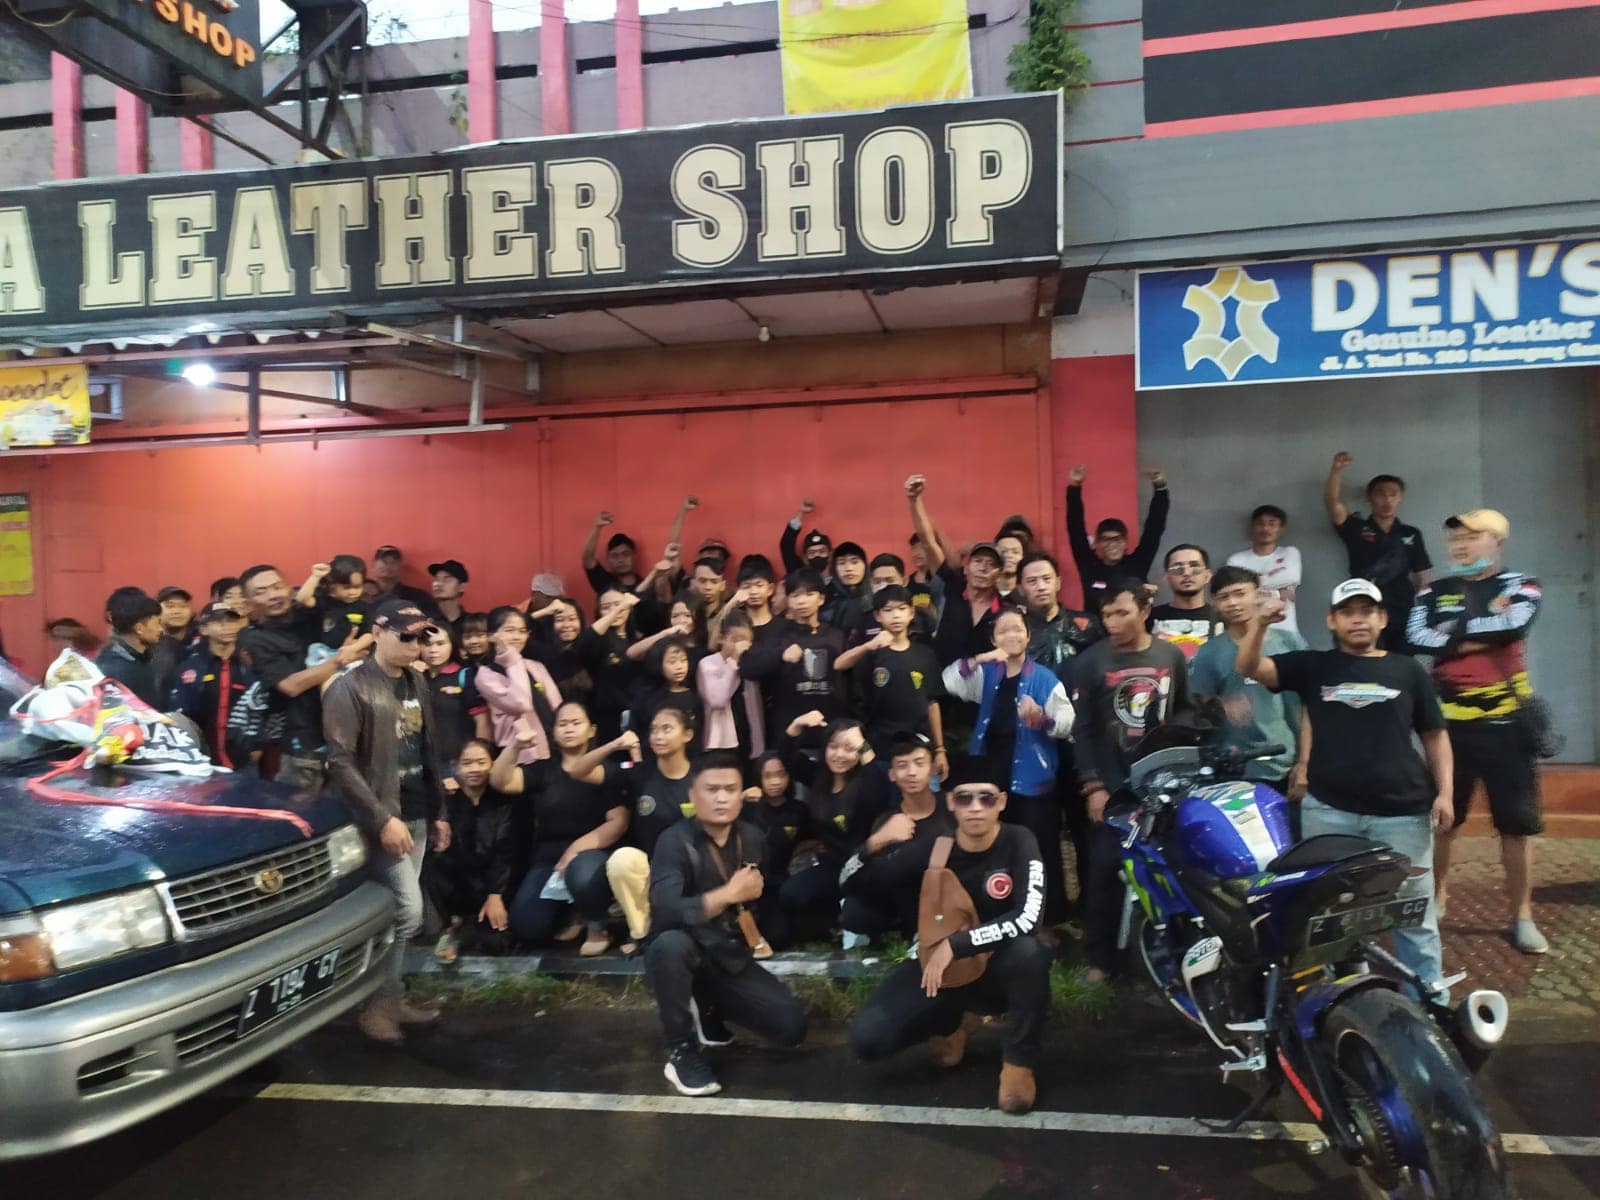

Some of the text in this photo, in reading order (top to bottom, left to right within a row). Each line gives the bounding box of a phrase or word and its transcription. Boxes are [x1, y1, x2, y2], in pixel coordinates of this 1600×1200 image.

[155, 0, 256, 68] SHOP
[78, 156, 626, 311] LEATHER
[670, 118, 1033, 268] SHOP
[1311, 243, 1600, 332] DEN'S
[1341, 317, 1596, 352] Genuine Leather
